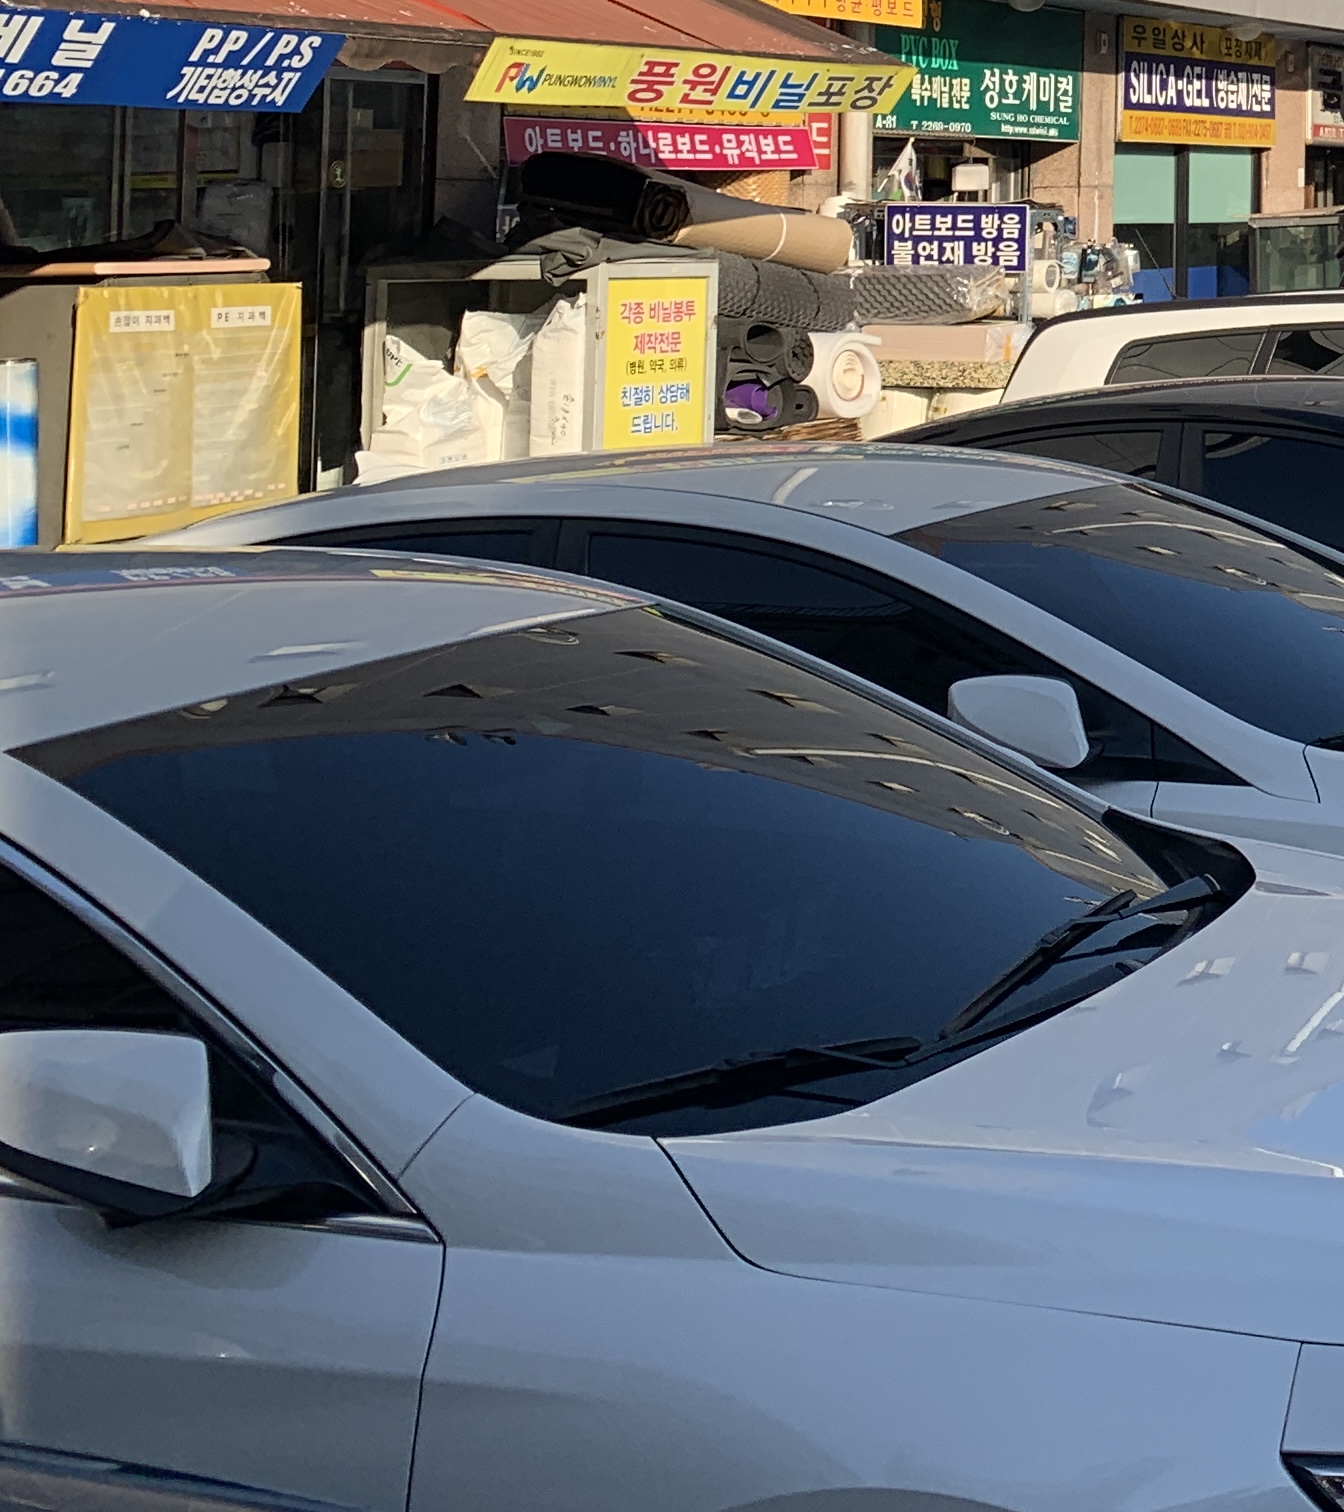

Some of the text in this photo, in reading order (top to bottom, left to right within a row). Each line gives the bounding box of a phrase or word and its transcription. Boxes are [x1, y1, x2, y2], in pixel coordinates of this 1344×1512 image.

[901, 34, 960, 71] PVC BOX
[1131, 23, 1206, 55] 우일상사
[0, 69, 85, 98] 664
[165, 65, 302, 106] 기타합성수지
[626, 58, 895, 111] 풍원비닐포장
[979, 67, 1074, 113] 성호케미컬
[989, 111, 1071, 126] SUNG HO CHEMICAL
[891, 212, 1022, 239] 아트보드 방음
[971, 240, 1021, 267] 방음
[619, 299, 697, 325] 각종 비닐봉투
[632, 331, 683, 356] 제작전문
[620, 381, 691, 408] 친절히 상담해
